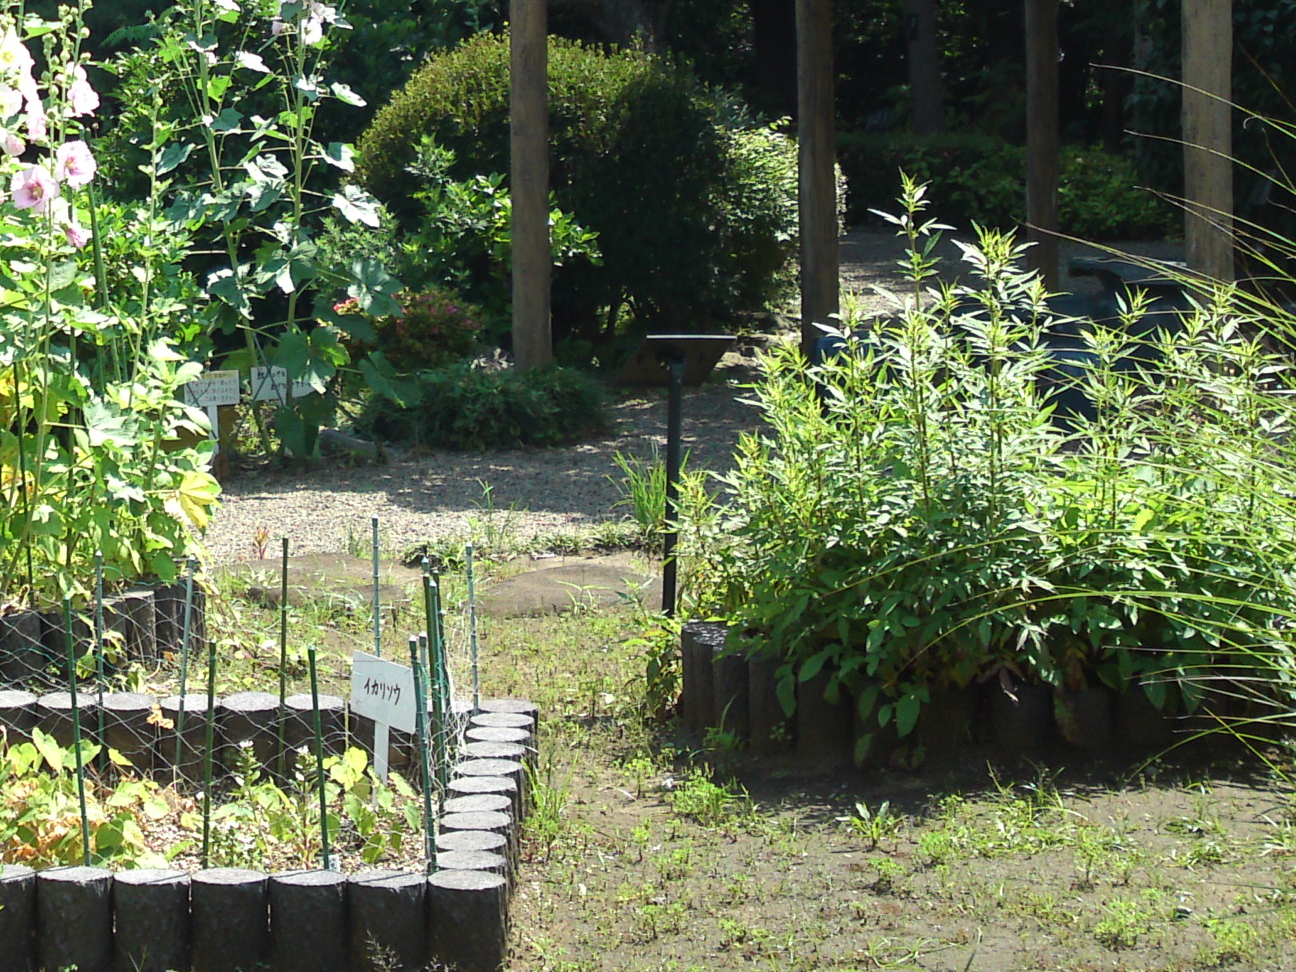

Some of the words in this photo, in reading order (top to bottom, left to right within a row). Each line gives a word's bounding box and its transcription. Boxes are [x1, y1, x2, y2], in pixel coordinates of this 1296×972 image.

[363, 677, 401, 705] イカリソウ
